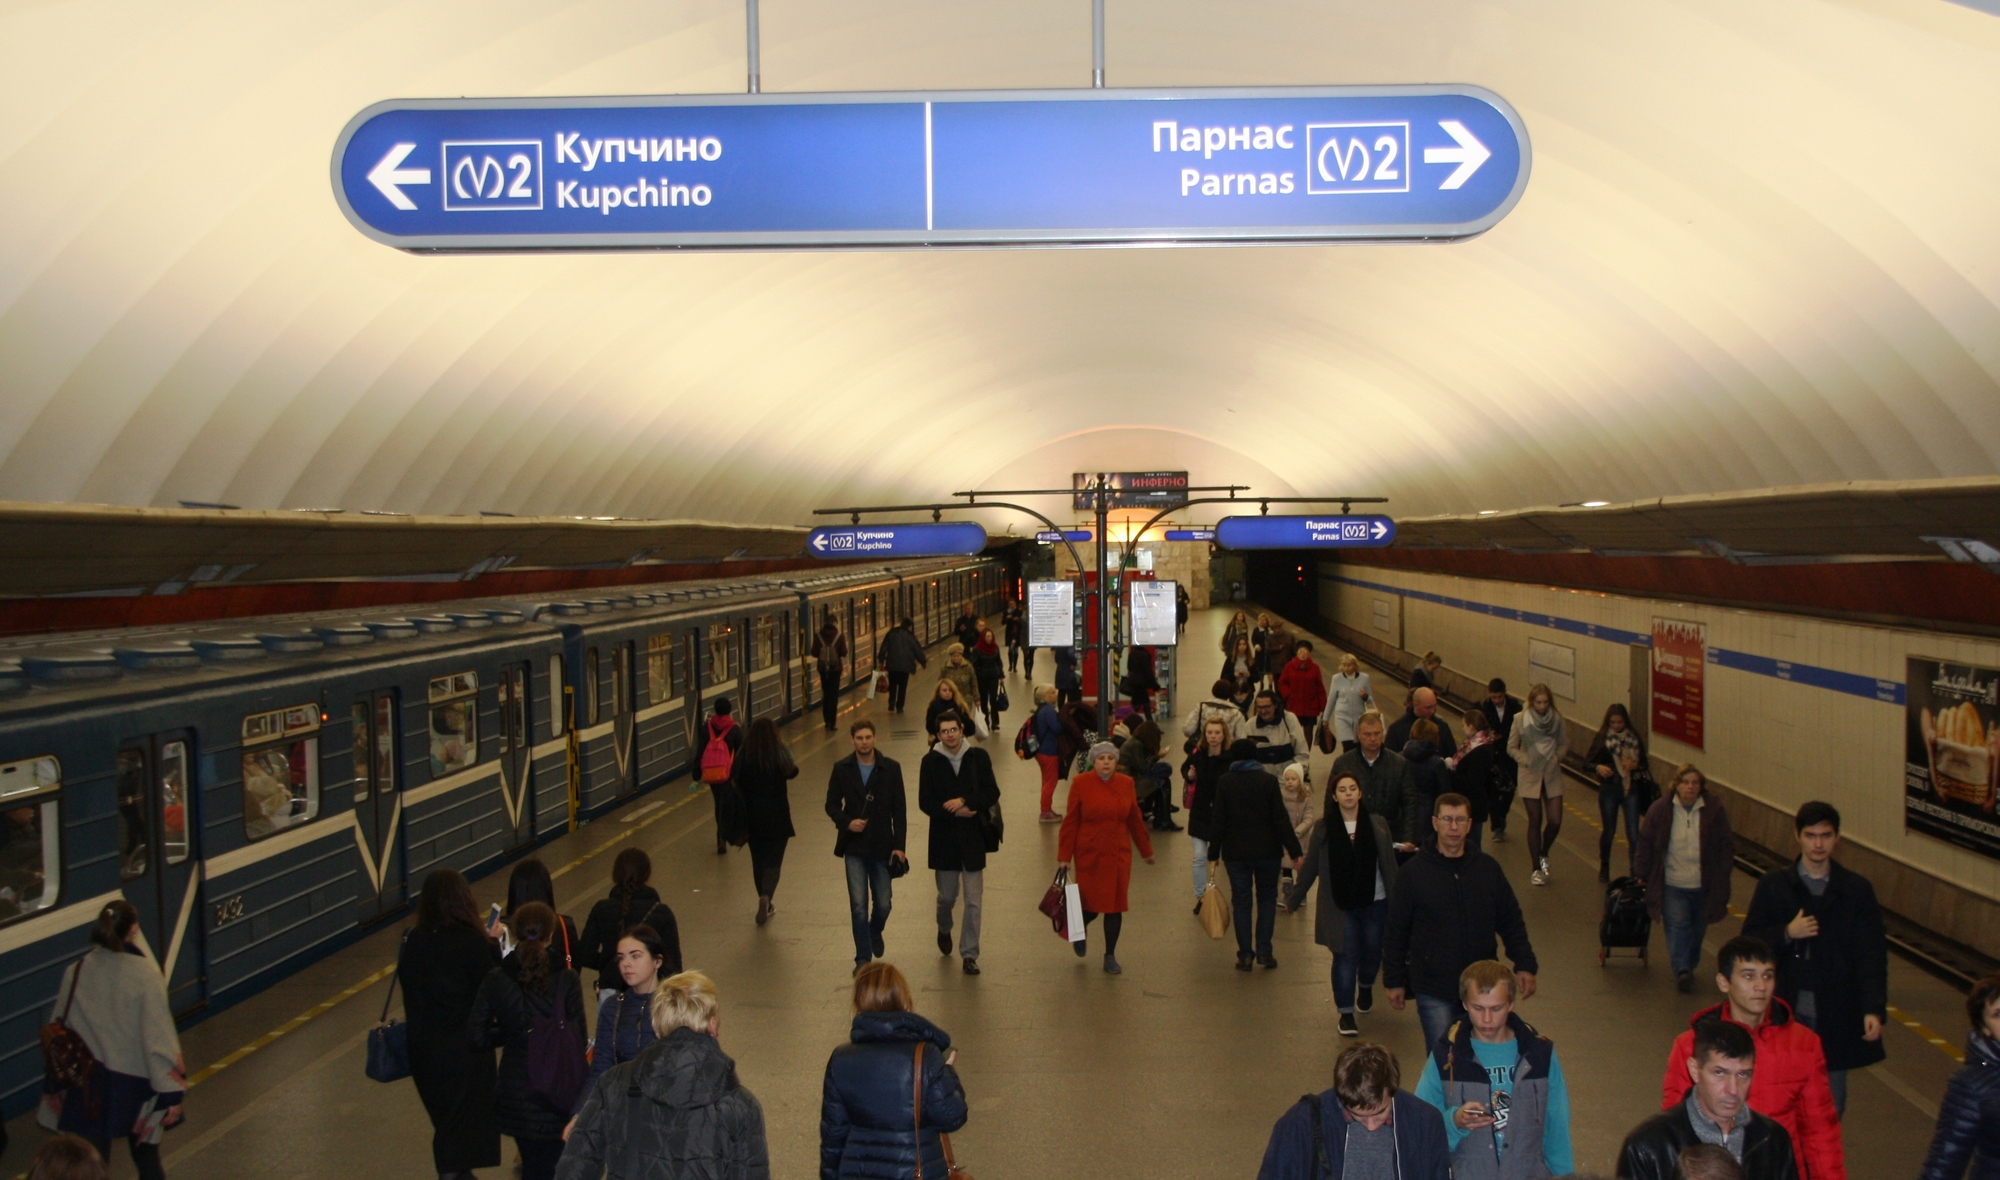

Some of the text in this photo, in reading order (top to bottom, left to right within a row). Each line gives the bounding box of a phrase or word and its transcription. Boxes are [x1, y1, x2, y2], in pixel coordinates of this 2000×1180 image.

[1152, 121, 1294, 160] Парнас
[556, 132, 722, 172] Купчино
[1181, 168, 1295, 197] Parnas
[556, 177, 712, 215] Kupchino
[1131, 477, 1186, 488] ИНФЕРНО
[1306, 521, 1340, 531] Парнас
[857, 531, 894, 541] Купчино
[1312, 532, 1340, 540] Parnas
[857, 541, 892, 551] Kupchino
